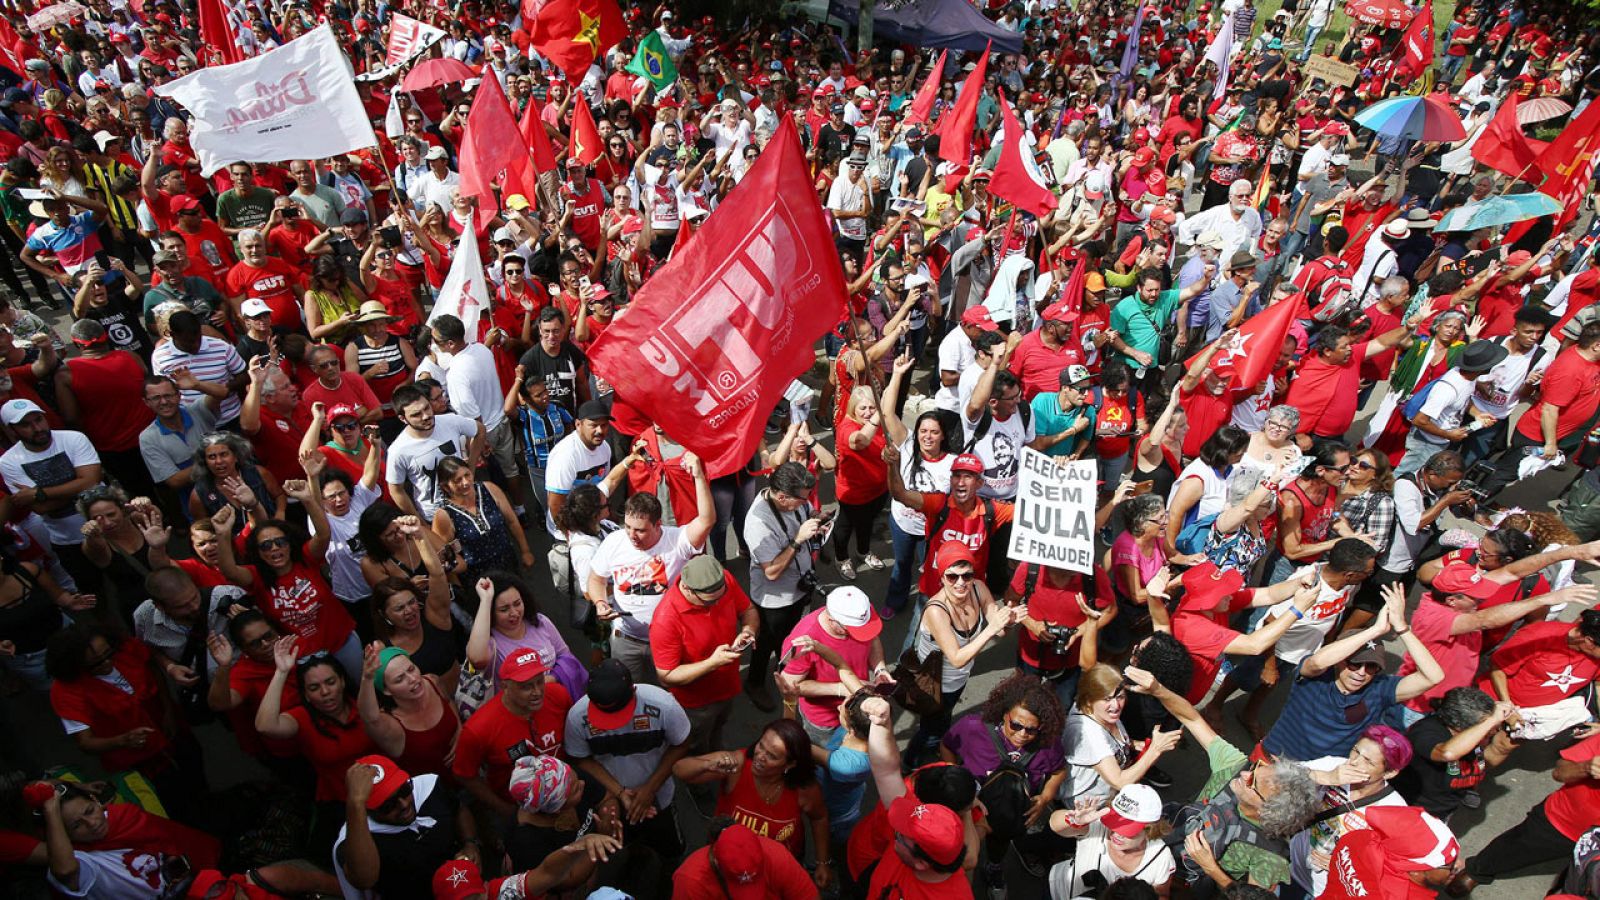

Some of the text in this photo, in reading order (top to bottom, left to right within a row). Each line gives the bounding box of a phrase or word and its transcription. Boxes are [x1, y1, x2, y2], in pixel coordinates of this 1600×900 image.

[573, 203, 597, 216] CUT
[1030, 480, 1082, 504] SEM
[1019, 498, 1090, 542] LULA
[943, 529, 983, 550] CUT
[1014, 532, 1090, 567] É FRAUDE!
